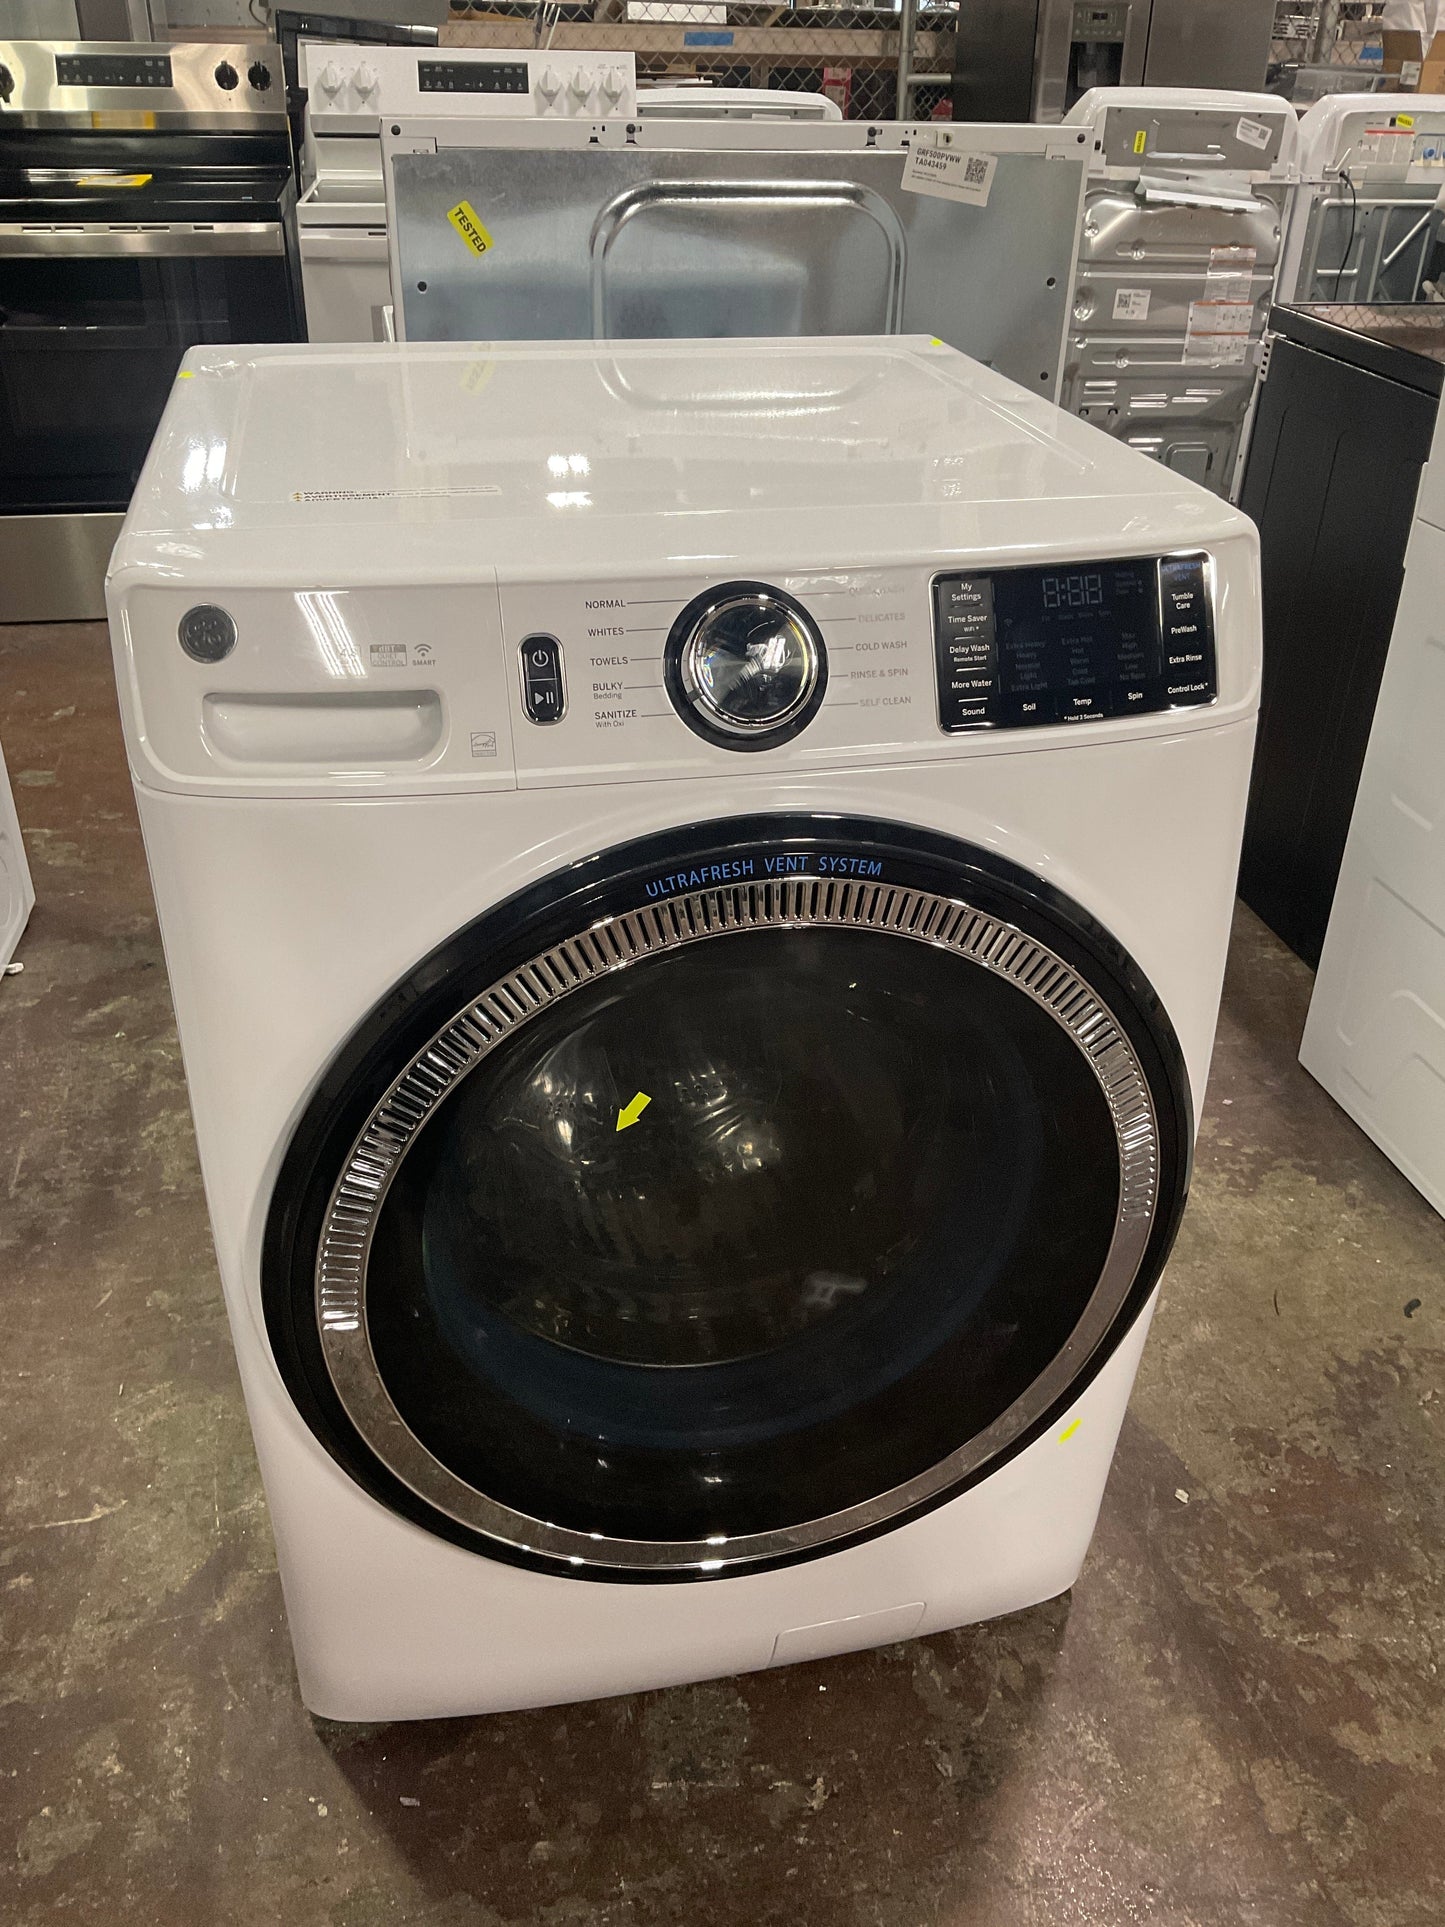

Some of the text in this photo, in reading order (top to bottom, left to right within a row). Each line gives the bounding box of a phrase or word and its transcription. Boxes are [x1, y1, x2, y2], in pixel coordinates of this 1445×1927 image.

[916, 147, 962, 164] GRF500PVWW
[915, 156, 948, 171] TA043459
[454, 207, 487, 253] TESTED
[961, 582, 973, 592] My
[951, 591, 982, 602] Settings
[1172, 592, 1194, 601] Tumble
[585, 599, 626, 609] NORMAL
[1176, 602, 1191, 610] Care
[858, 612, 906, 623] DELICATES
[948, 614, 988, 624] Time Saver
[587, 627, 625, 637] WHITES
[1171, 625, 1197, 634] PreWash
[855, 640, 908, 651] COLD WASH
[949, 644, 990, 655] Delay Wash
[412, 659, 436, 667] SMART
[590, 656, 629, 666] TOWELS
[1169, 653, 1202, 664] Extra Rinse
[850, 668, 909, 680] RINSE & SPIN
[592, 682, 623, 692] BULKY
[951, 679, 992, 690] More Water
[1167, 684, 1188, 694] Control
[593, 691, 622, 700] Bedding
[1127, 691, 1143, 701] Spin
[859, 696, 912, 708] SELF CLEAN
[1072, 698, 1092, 707] Temp
[962, 707, 986, 716] Sound
[1022, 703, 1037, 712] Soil
[594, 709, 638, 720] SANITIZE
[1083, 713, 1104, 721] Seconds
[595, 720, 625, 729] With Oxi
[645, 856, 883, 898] ULTRAFRESH VENT SYSTEM
